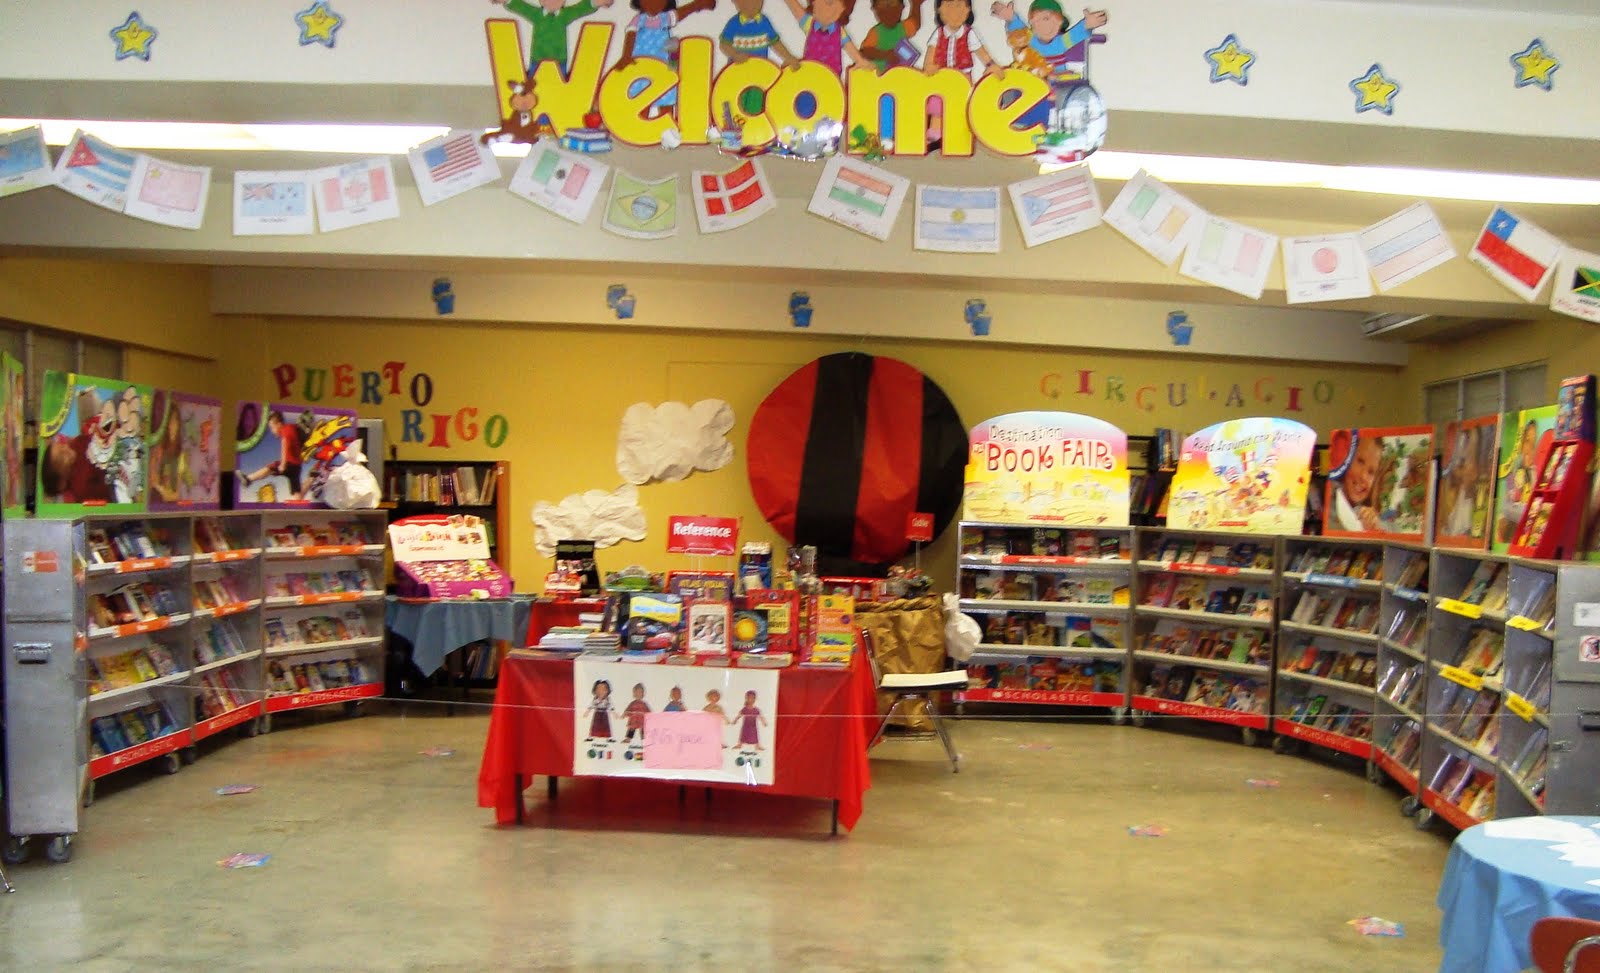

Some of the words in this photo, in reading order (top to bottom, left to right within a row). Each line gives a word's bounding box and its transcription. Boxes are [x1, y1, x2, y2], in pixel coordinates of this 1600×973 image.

[485, 18, 1051, 158] Welcome
[272, 361, 433, 407] PUERTO
[401, 407, 509, 448] RICO
[989, 425, 1063, 443] Destination
[987, 442, 1054, 473] BOOK
[1062, 440, 1113, 471] FAIR
[673, 522, 732, 538] Reference
[301, 687, 361, 704] SCHOLASTIC
[1003, 691, 1091, 704] SCHOLASTIC
[120, 737, 174, 764] SCHOLASTIC
